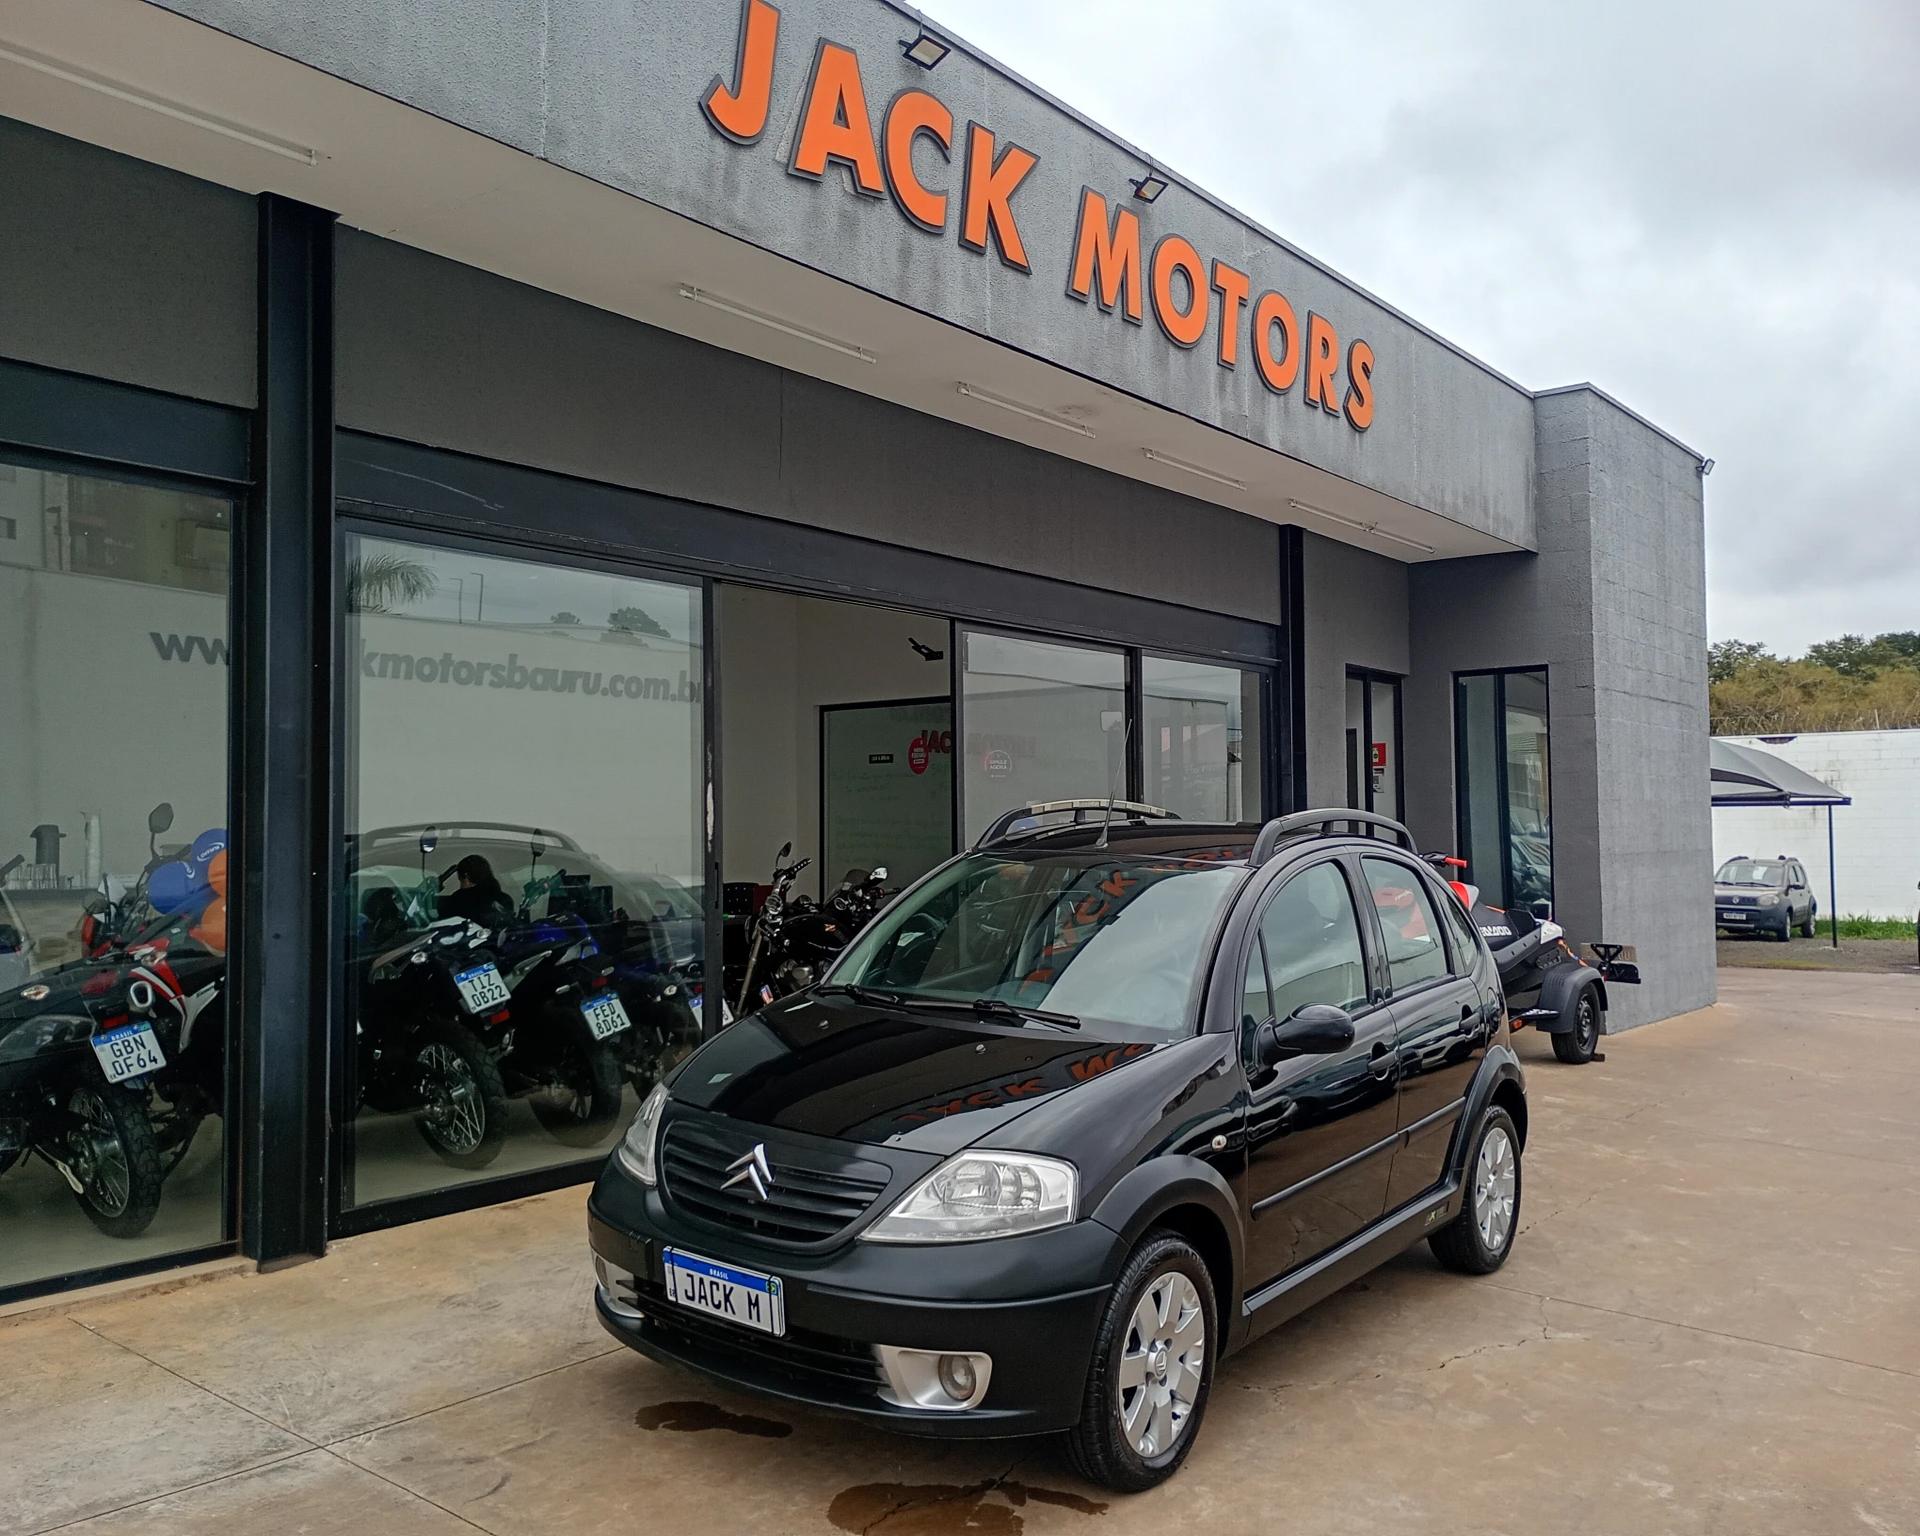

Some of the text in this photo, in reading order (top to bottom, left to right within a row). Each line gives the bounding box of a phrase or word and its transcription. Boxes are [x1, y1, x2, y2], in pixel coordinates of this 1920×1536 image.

[701, 0, 1376, 432] JACK MOTORS
[468, 973, 495, 992] TIZ
[593, 1002, 617, 1021] FED
[596, 1013, 625, 1035] 8D61
[110, 1034, 147, 1058] GBN
[709, 1268, 729, 1281] BRASIL
[684, 1272, 761, 1323] JACK M
